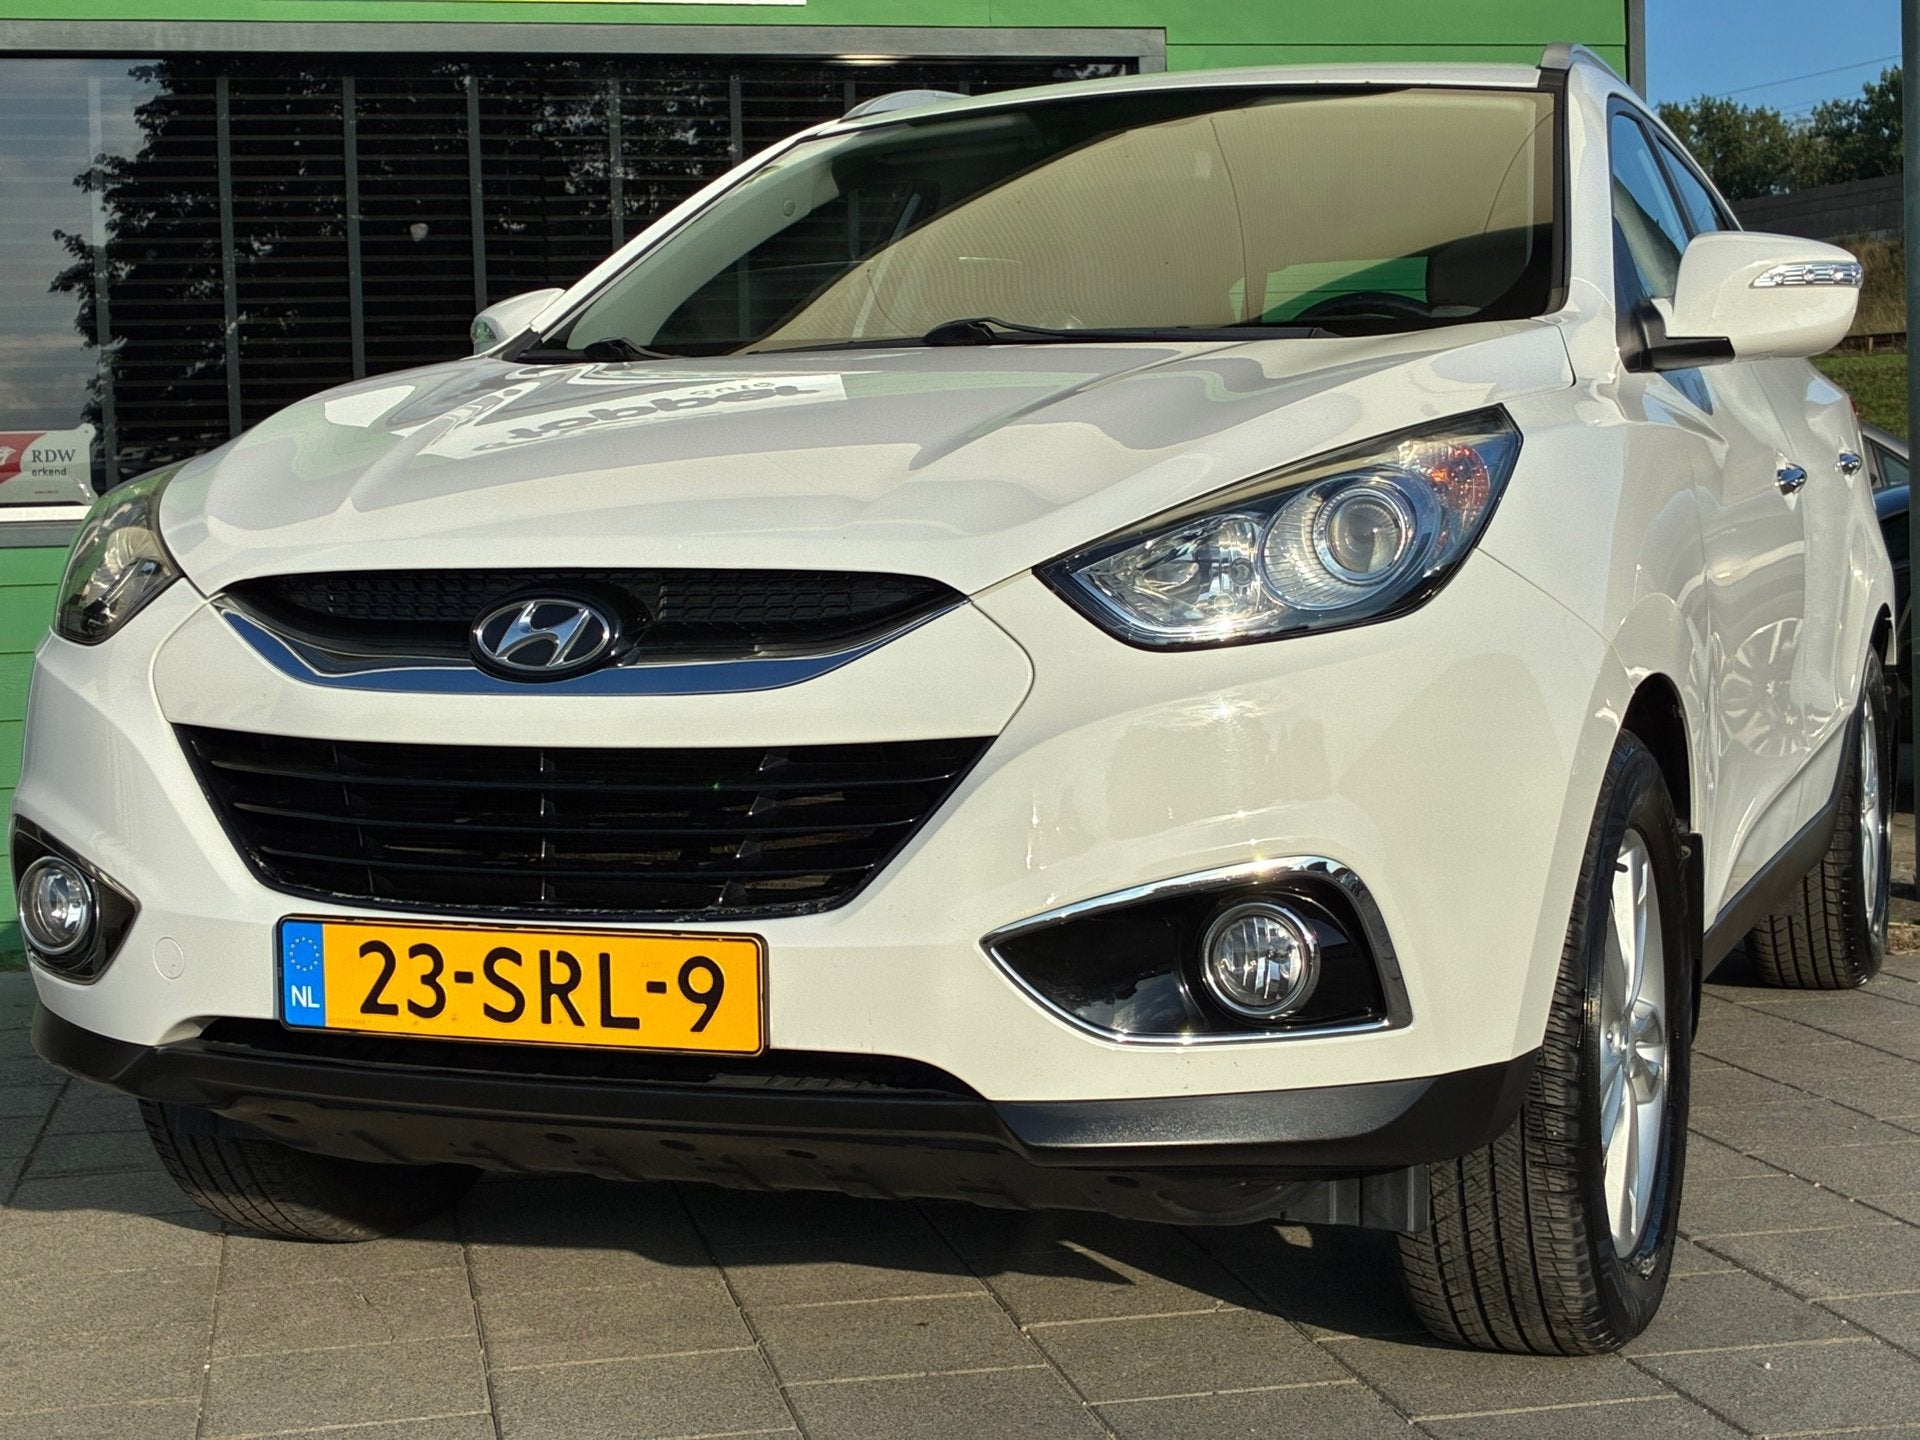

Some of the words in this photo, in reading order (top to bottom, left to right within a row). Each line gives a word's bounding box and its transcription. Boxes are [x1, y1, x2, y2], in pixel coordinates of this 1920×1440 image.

[31, 449, 76, 463] RDW
[31, 467, 67, 477] erkend
[358, 939, 726, 1033] 23-SRL-9
[291, 984, 320, 1008] NL
